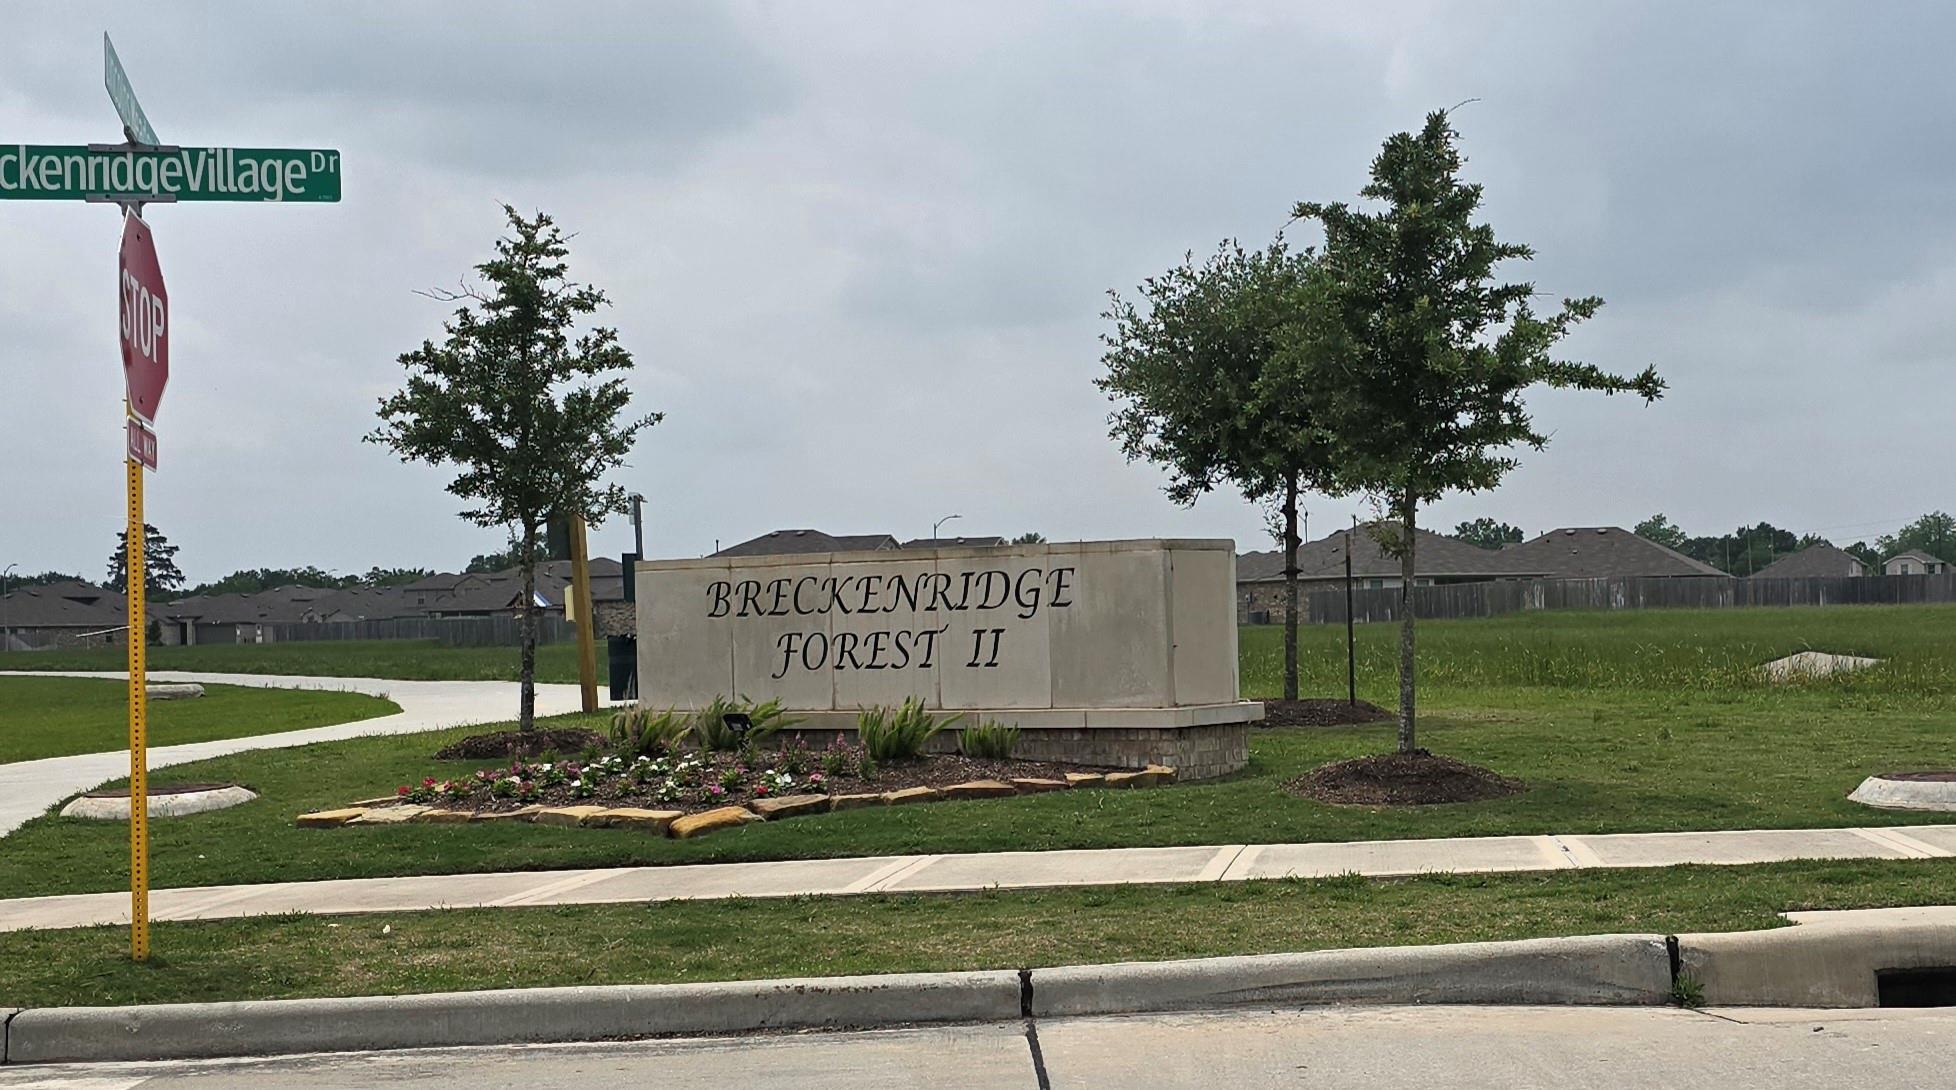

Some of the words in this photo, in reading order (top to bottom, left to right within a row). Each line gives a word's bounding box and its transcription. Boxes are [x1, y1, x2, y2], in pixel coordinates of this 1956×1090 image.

[311, 152, 338, 173] Dr
[123, 268, 165, 364] STOP
[706, 567, 1075, 619] BRECKENRIDGE
[772, 624, 949, 679] FOREST
[966, 628, 1006, 668] II
